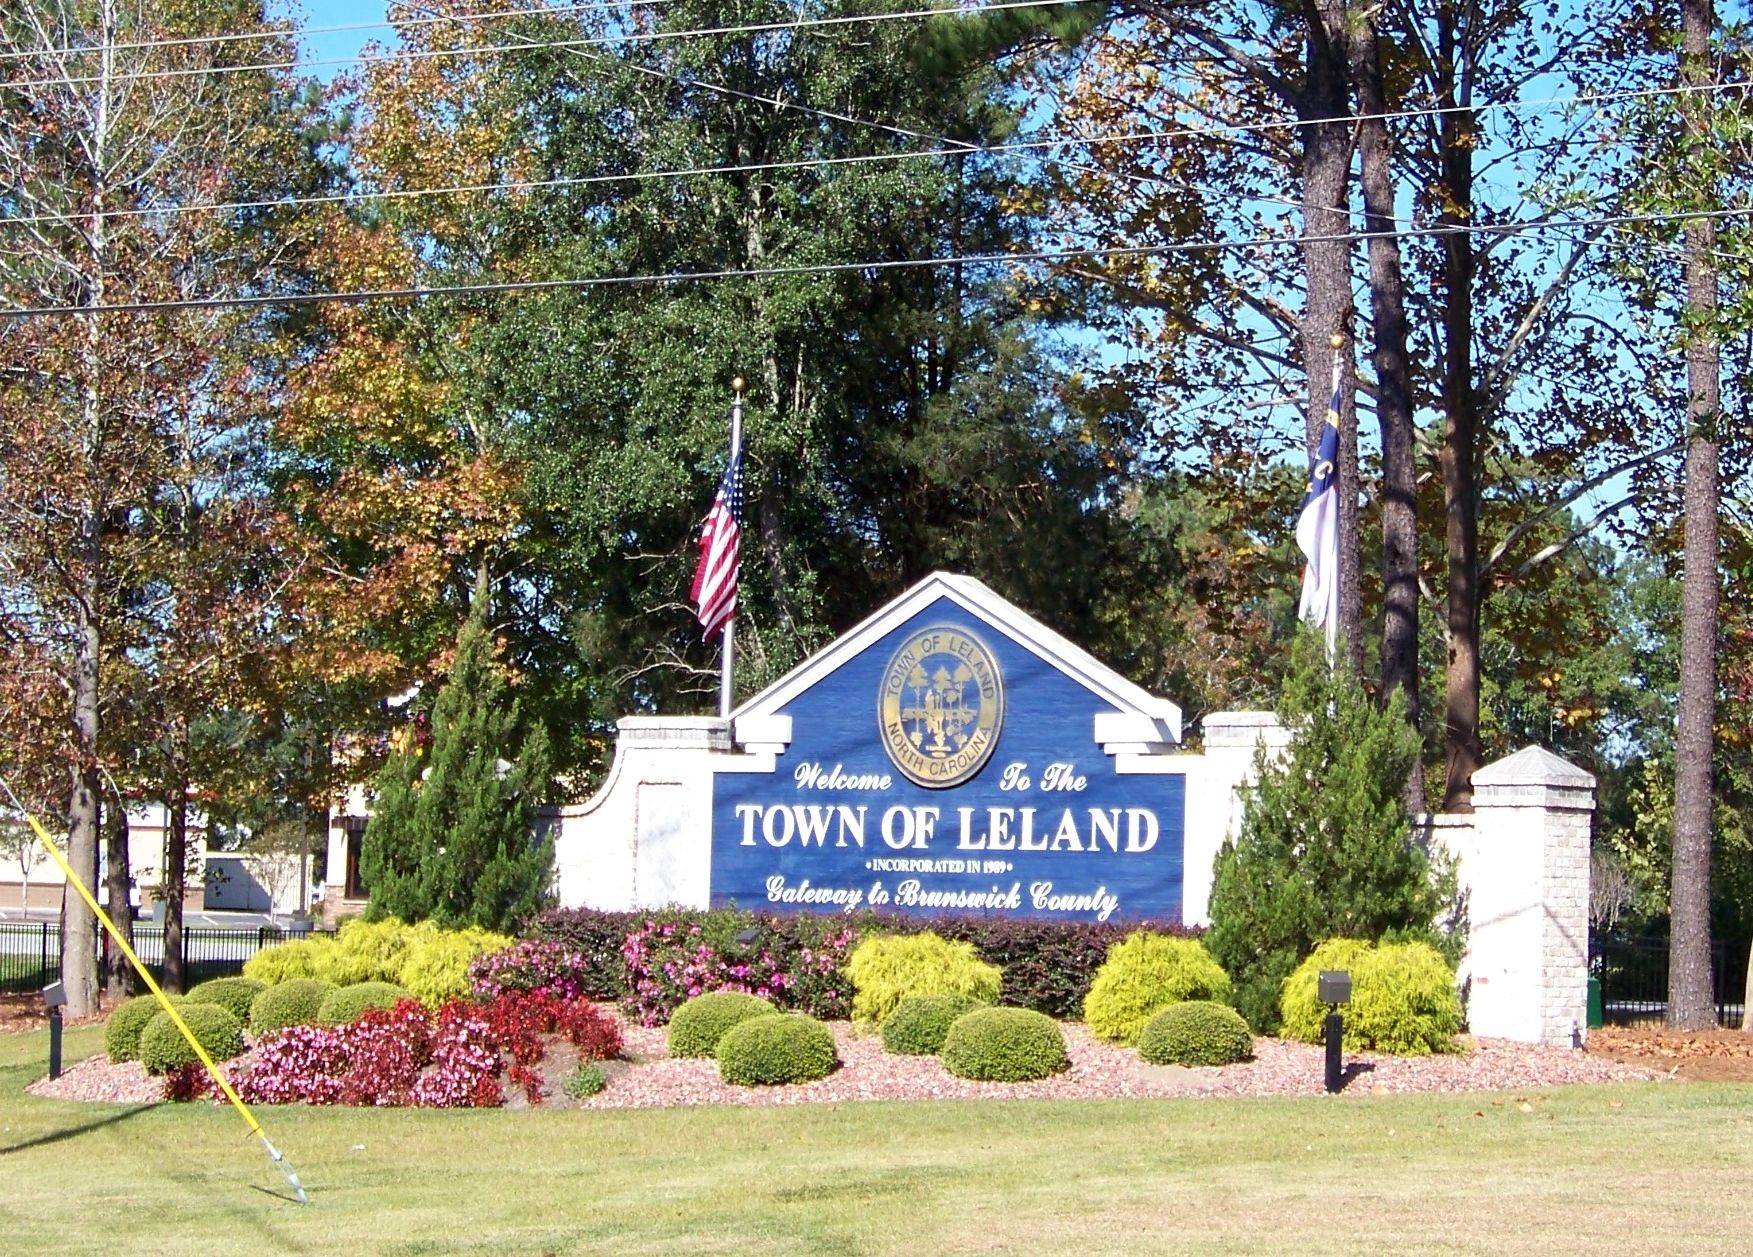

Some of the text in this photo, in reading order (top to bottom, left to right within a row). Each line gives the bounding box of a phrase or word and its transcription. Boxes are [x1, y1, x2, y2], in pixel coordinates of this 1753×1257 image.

[887, 635, 995, 699] TOWN OF LELAND
[887, 722, 991, 776] NORTH CAROLINA
[794, 762, 1087, 792] Welcome To The
[735, 804, 1159, 852] TOWN OF LELAND
[872, 858, 965, 873] INCORPORATED
[966, 860, 981, 873] IN
[766, 875, 1119, 922] Gateway to Brunswick County
